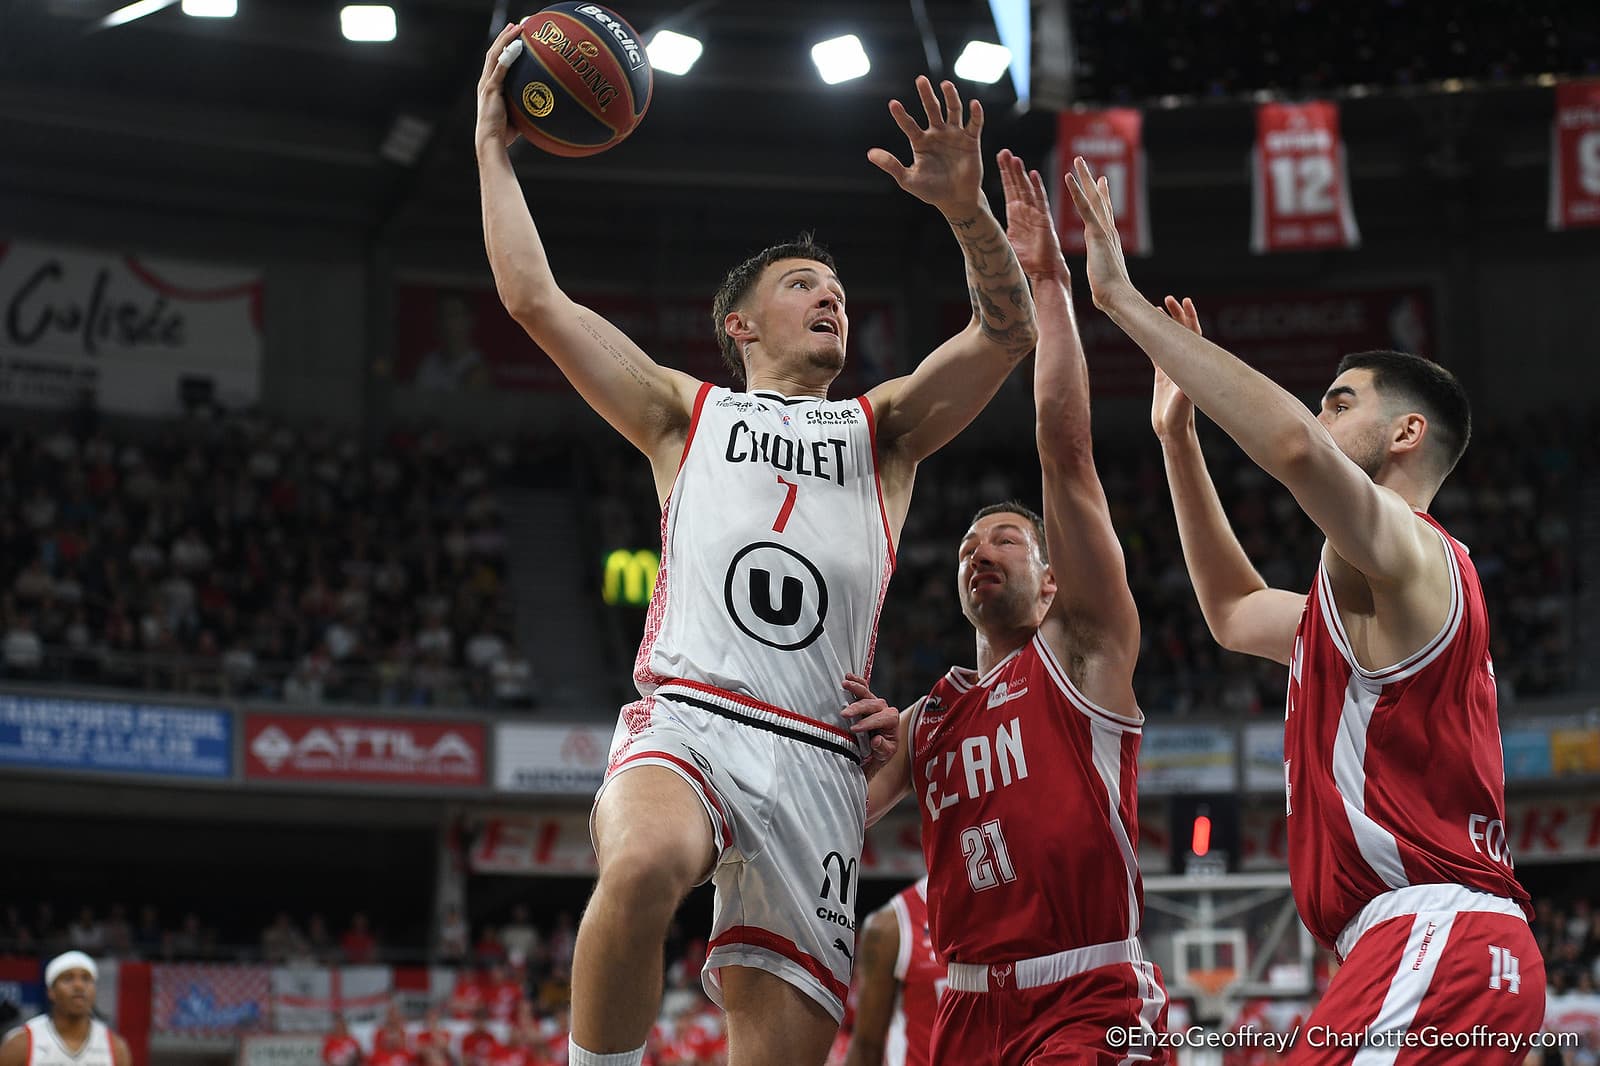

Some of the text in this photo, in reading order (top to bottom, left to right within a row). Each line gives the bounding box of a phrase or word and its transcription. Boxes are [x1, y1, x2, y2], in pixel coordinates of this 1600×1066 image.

[532, 20, 618, 108] SPALDING
[582, 5, 642, 65] Betclic
[1272, 156, 1334, 215] 12
[725, 420, 847, 487] CHOLET
[772, 474, 798, 533] 7
[298, 726, 475, 762] ATTILA
[960, 817, 1017, 893] 21
[1412, 921, 1437, 971] RESPECT
[1488, 944, 1521, 995] 14
